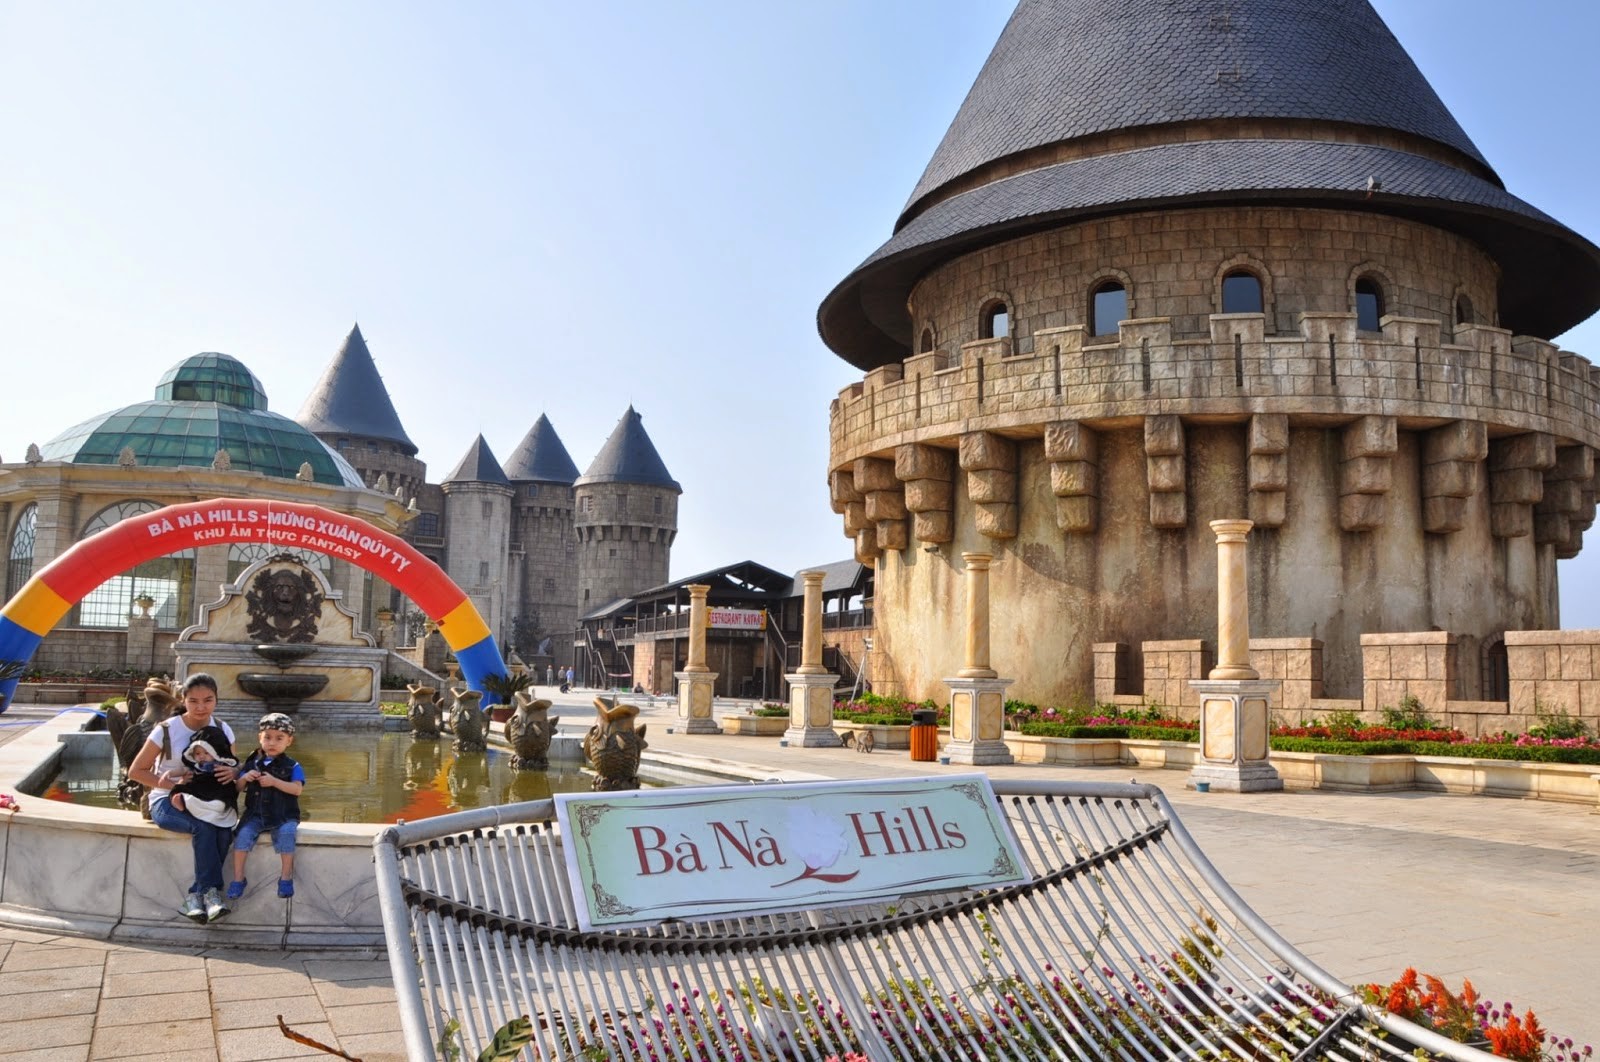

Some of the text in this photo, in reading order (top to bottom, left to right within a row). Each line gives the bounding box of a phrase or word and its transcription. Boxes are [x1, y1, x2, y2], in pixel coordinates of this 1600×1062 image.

[147, 518, 175, 537] BÀ
[177, 510, 205, 529] NÀ
[208, 509, 259, 523] HILLS
[316, 520, 360, 544] XUÂN
[359, 535, 391, 559] QÚY
[193, 527, 225, 541] KHU
[256, 528, 297, 541] THỰC
[301, 534, 362, 560] FANTASY
[625, 804, 969, 878] Bà Nà Hills
